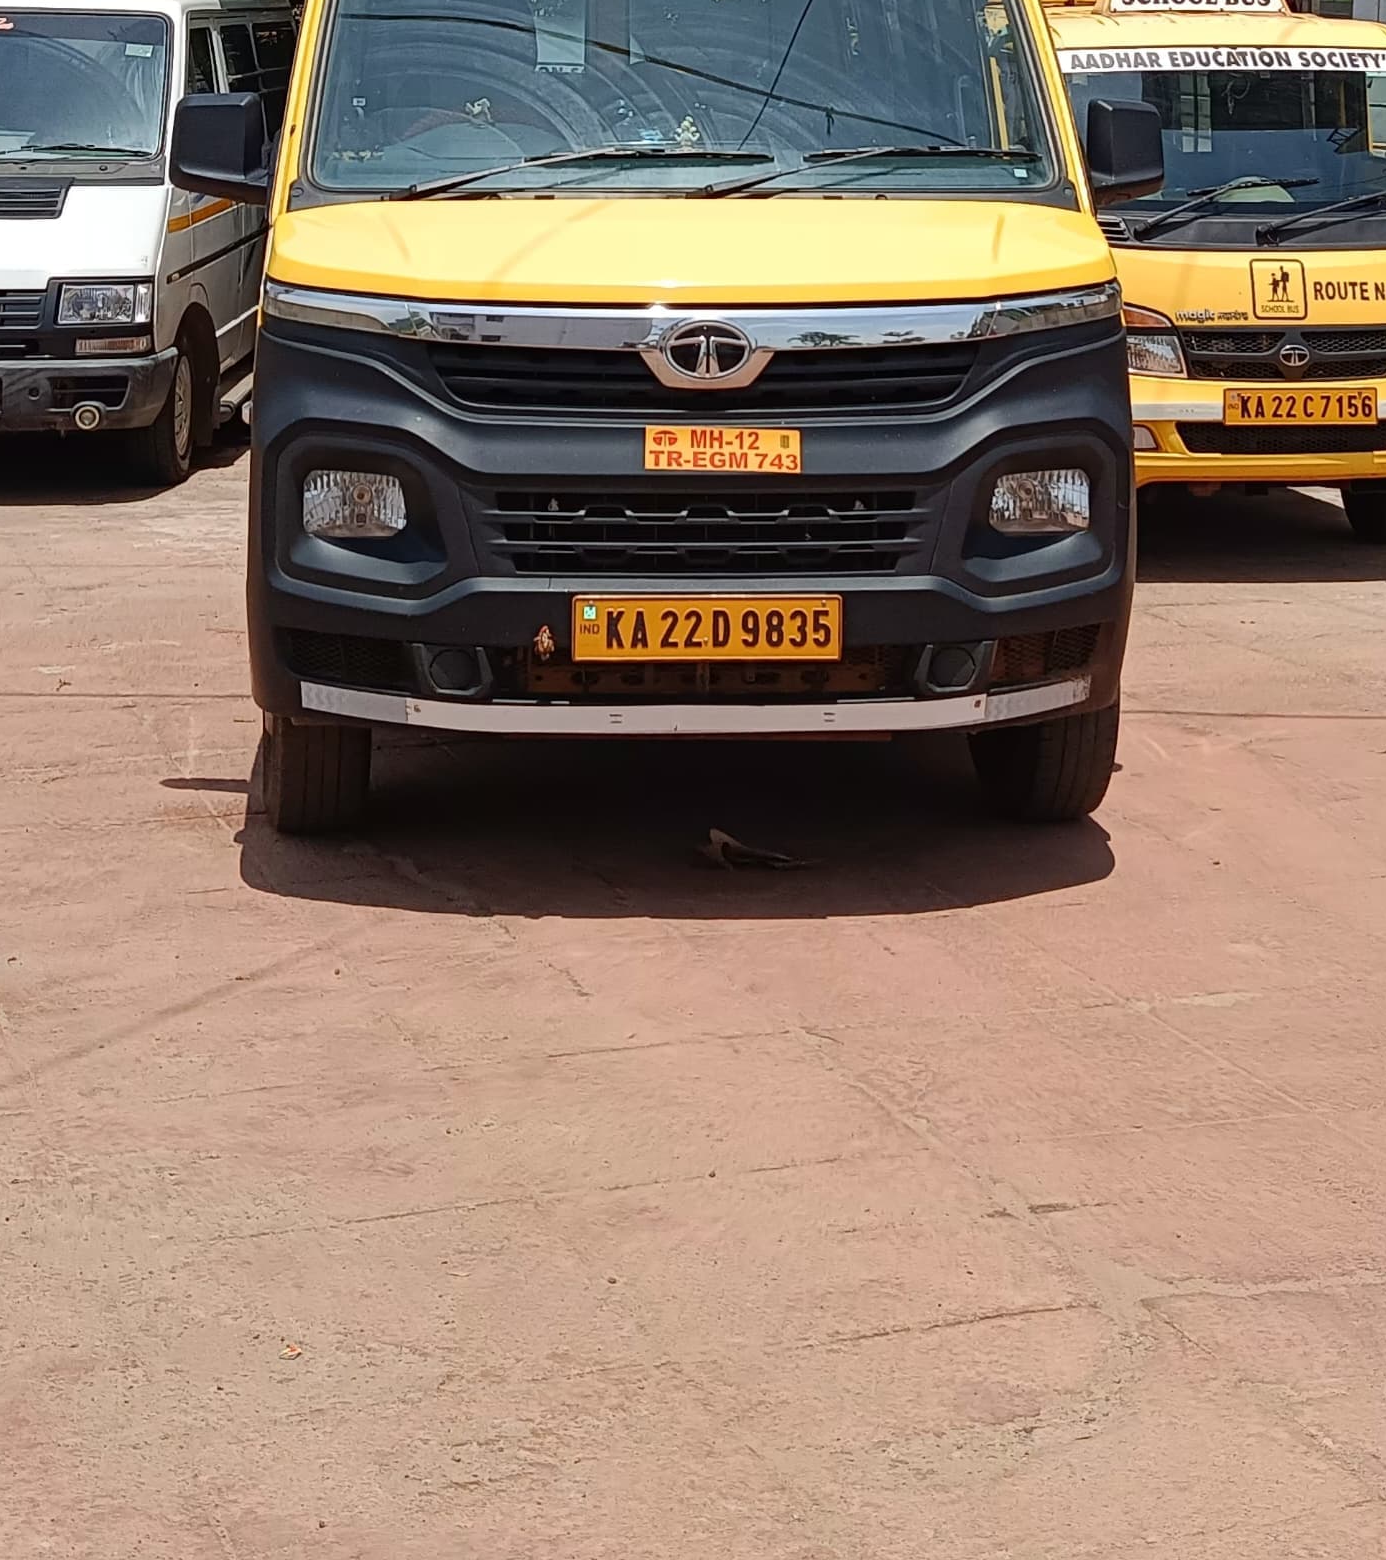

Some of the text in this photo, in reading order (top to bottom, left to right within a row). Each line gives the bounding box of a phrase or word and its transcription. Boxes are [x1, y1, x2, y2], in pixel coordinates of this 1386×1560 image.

[1071, 51, 1162, 70] AADHAR
[1168, 50, 1292, 68] EDUCATION
[1313, 281, 1370, 301] ROUTE
[1241, 395, 1373, 419] KA 22 C 7156
[690, 429, 759, 450] MH-12
[649, 450, 798, 471] TR-EGM 743
[579, 623, 600, 635] IND
[606, 609, 832, 649] KA 22 D 9835
